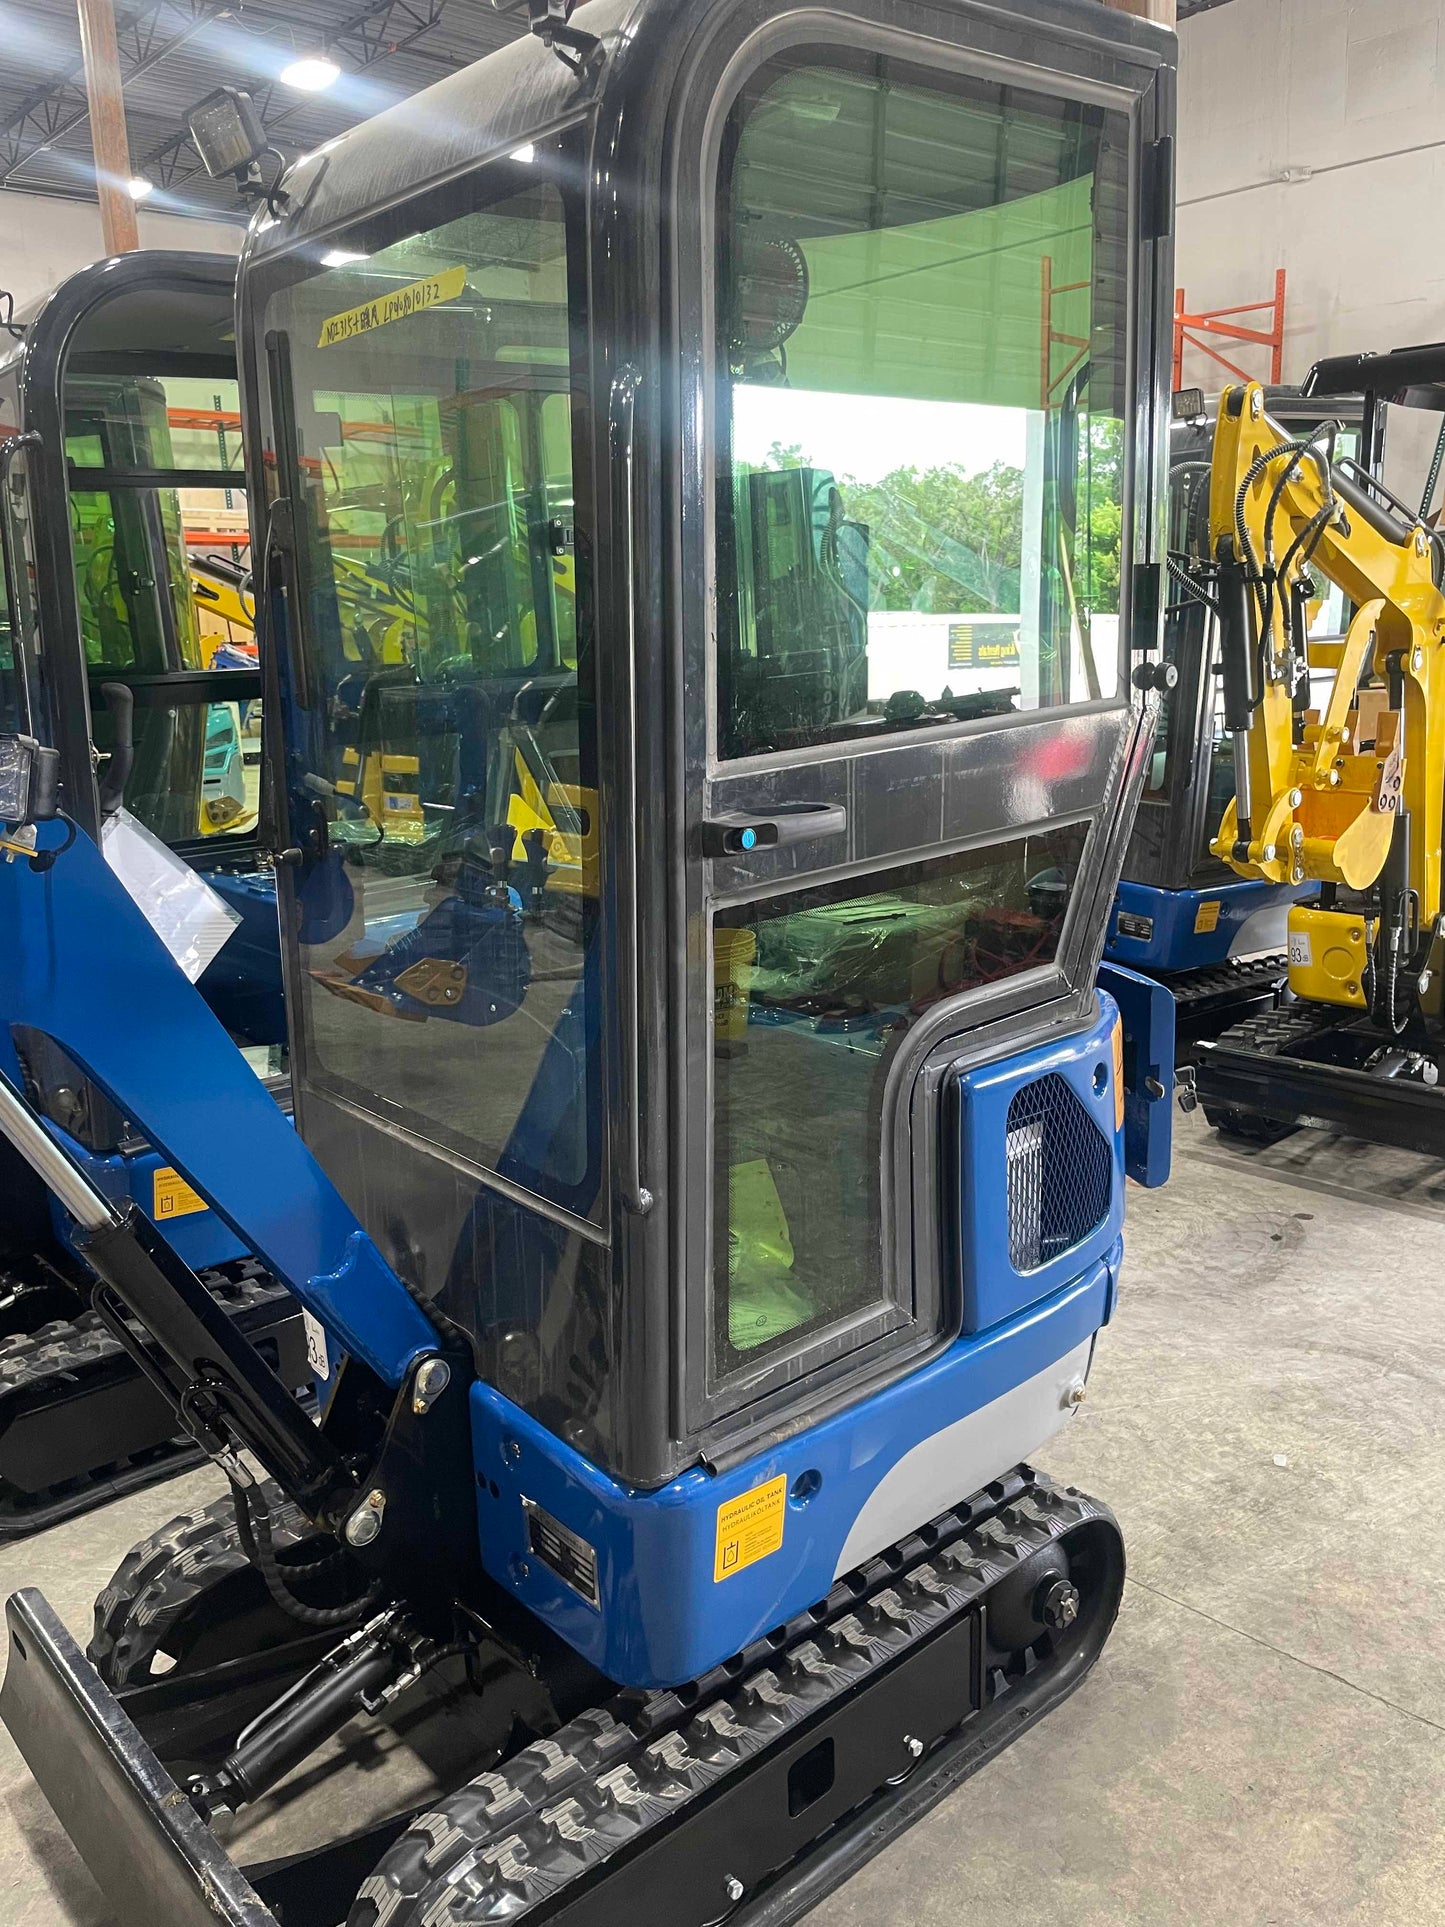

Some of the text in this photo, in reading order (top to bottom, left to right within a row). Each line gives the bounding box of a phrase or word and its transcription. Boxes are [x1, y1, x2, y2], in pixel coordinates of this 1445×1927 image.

[1290, 947, 1302, 963] 93
[721, 1487, 783, 1524] HYDRAULIC OIL TANK
